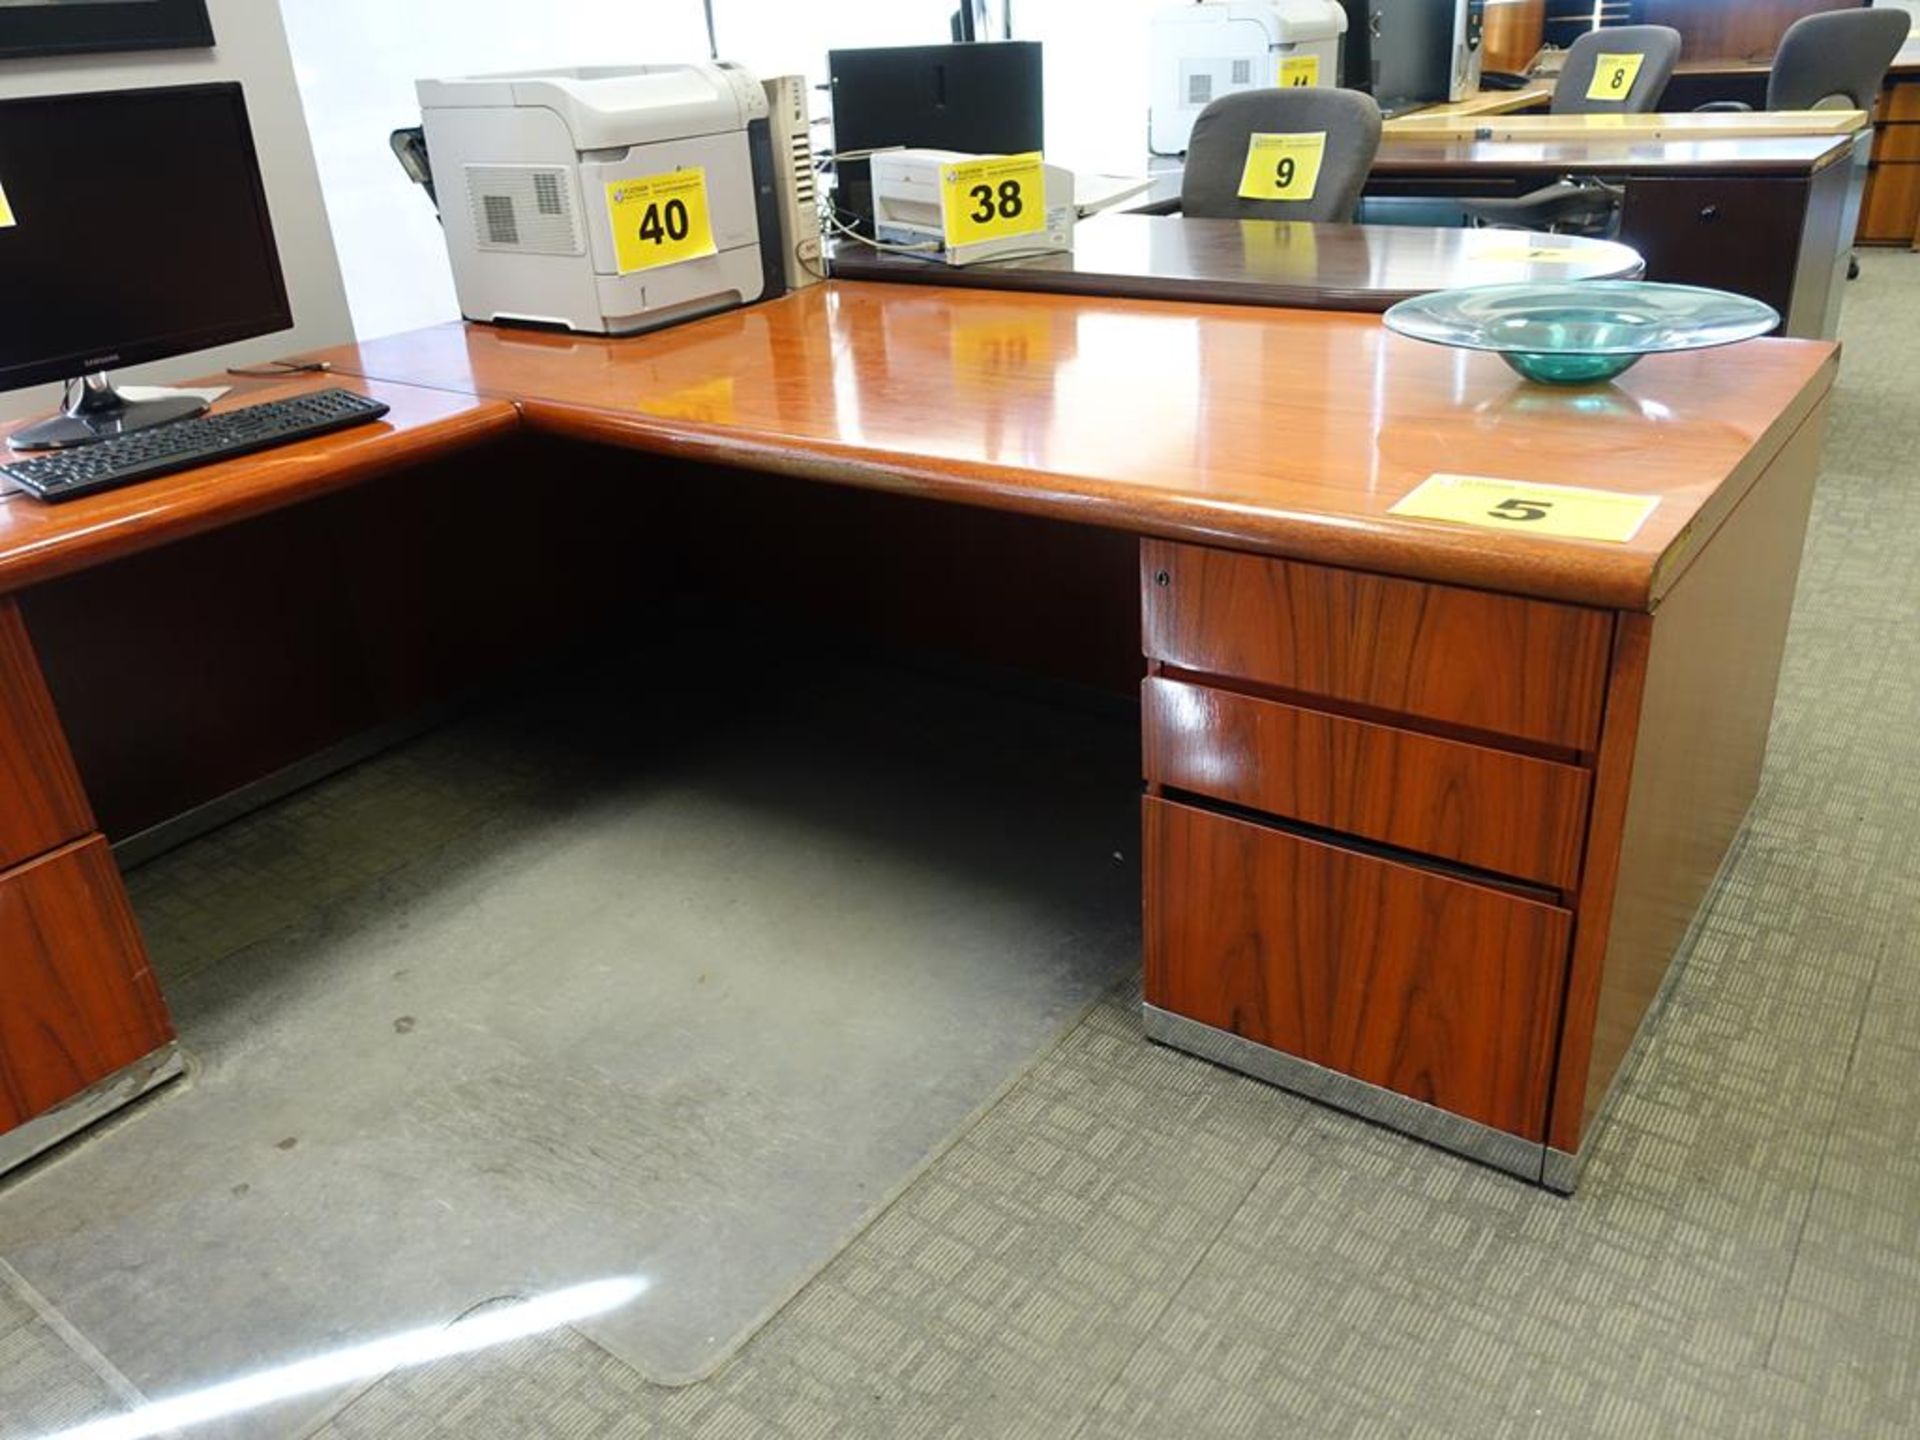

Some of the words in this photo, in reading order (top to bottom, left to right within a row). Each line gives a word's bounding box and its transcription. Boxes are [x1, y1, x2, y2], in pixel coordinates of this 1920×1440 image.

[1611, 68, 1625, 90] 8
[1275, 157, 1295, 189] 9
[970, 180, 1022, 224] 38
[639, 198, 689, 245] 40
[1487, 498, 1554, 521] 5
